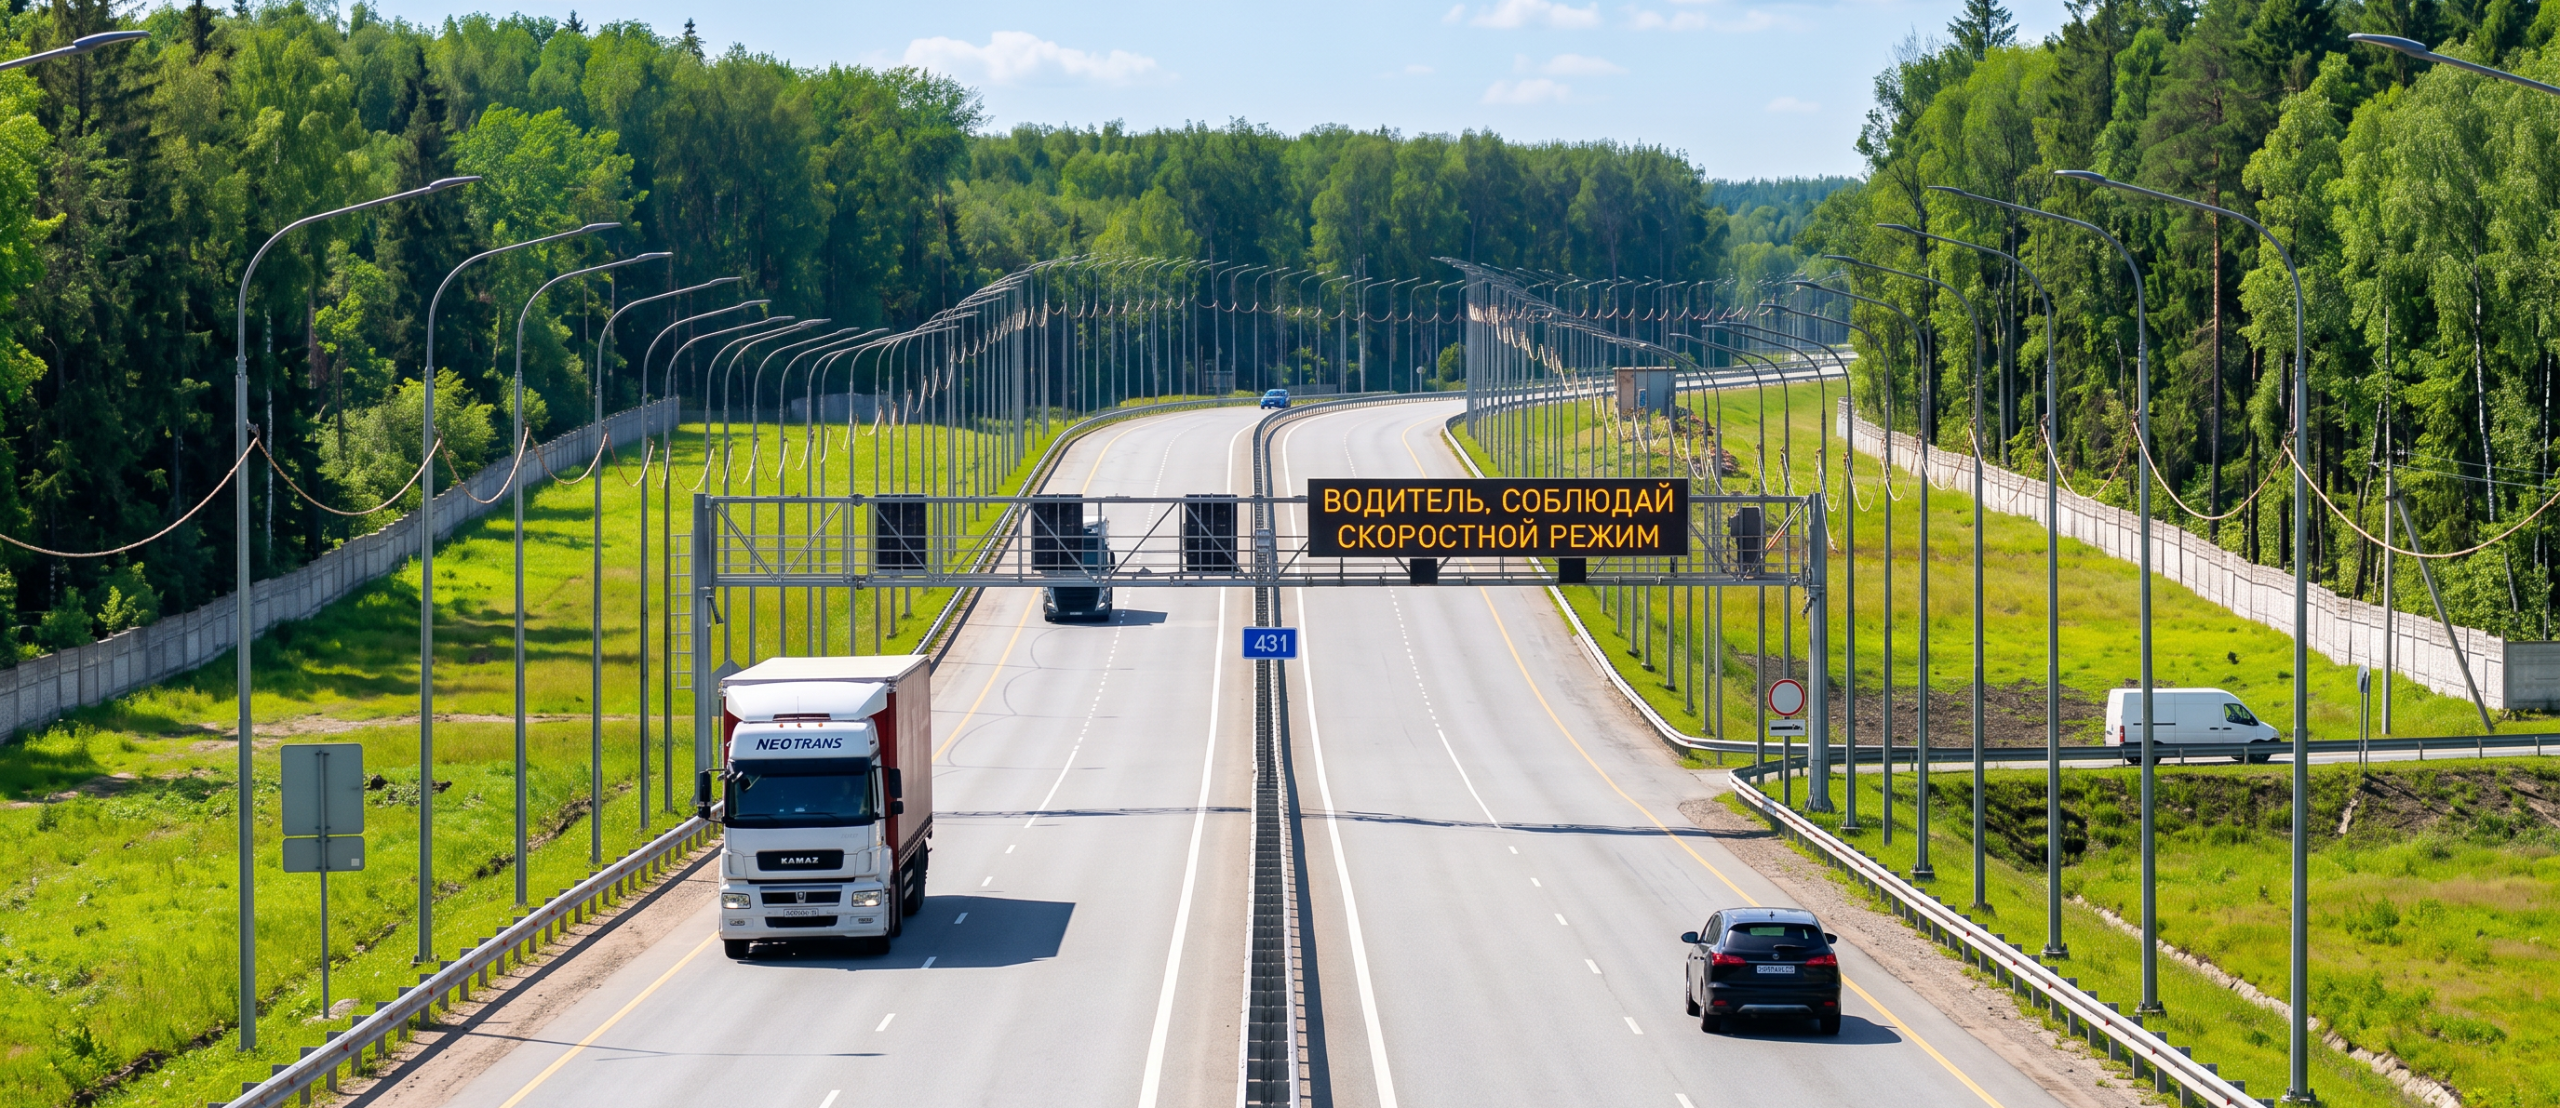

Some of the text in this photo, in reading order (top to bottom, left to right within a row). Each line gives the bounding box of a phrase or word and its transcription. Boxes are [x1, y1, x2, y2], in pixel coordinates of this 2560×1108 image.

[1324, 482, 1674, 518] ВОДИТЕЛЬ, СОБЛЮДАЙ
[1337, 517, 1659, 549] СКОРОСТНОЙ РЕЖИМ
[1253, 634, 1287, 653] 431
[755, 737, 843, 751] NEOTRANS
[780, 856, 819, 865] KAMAZ
